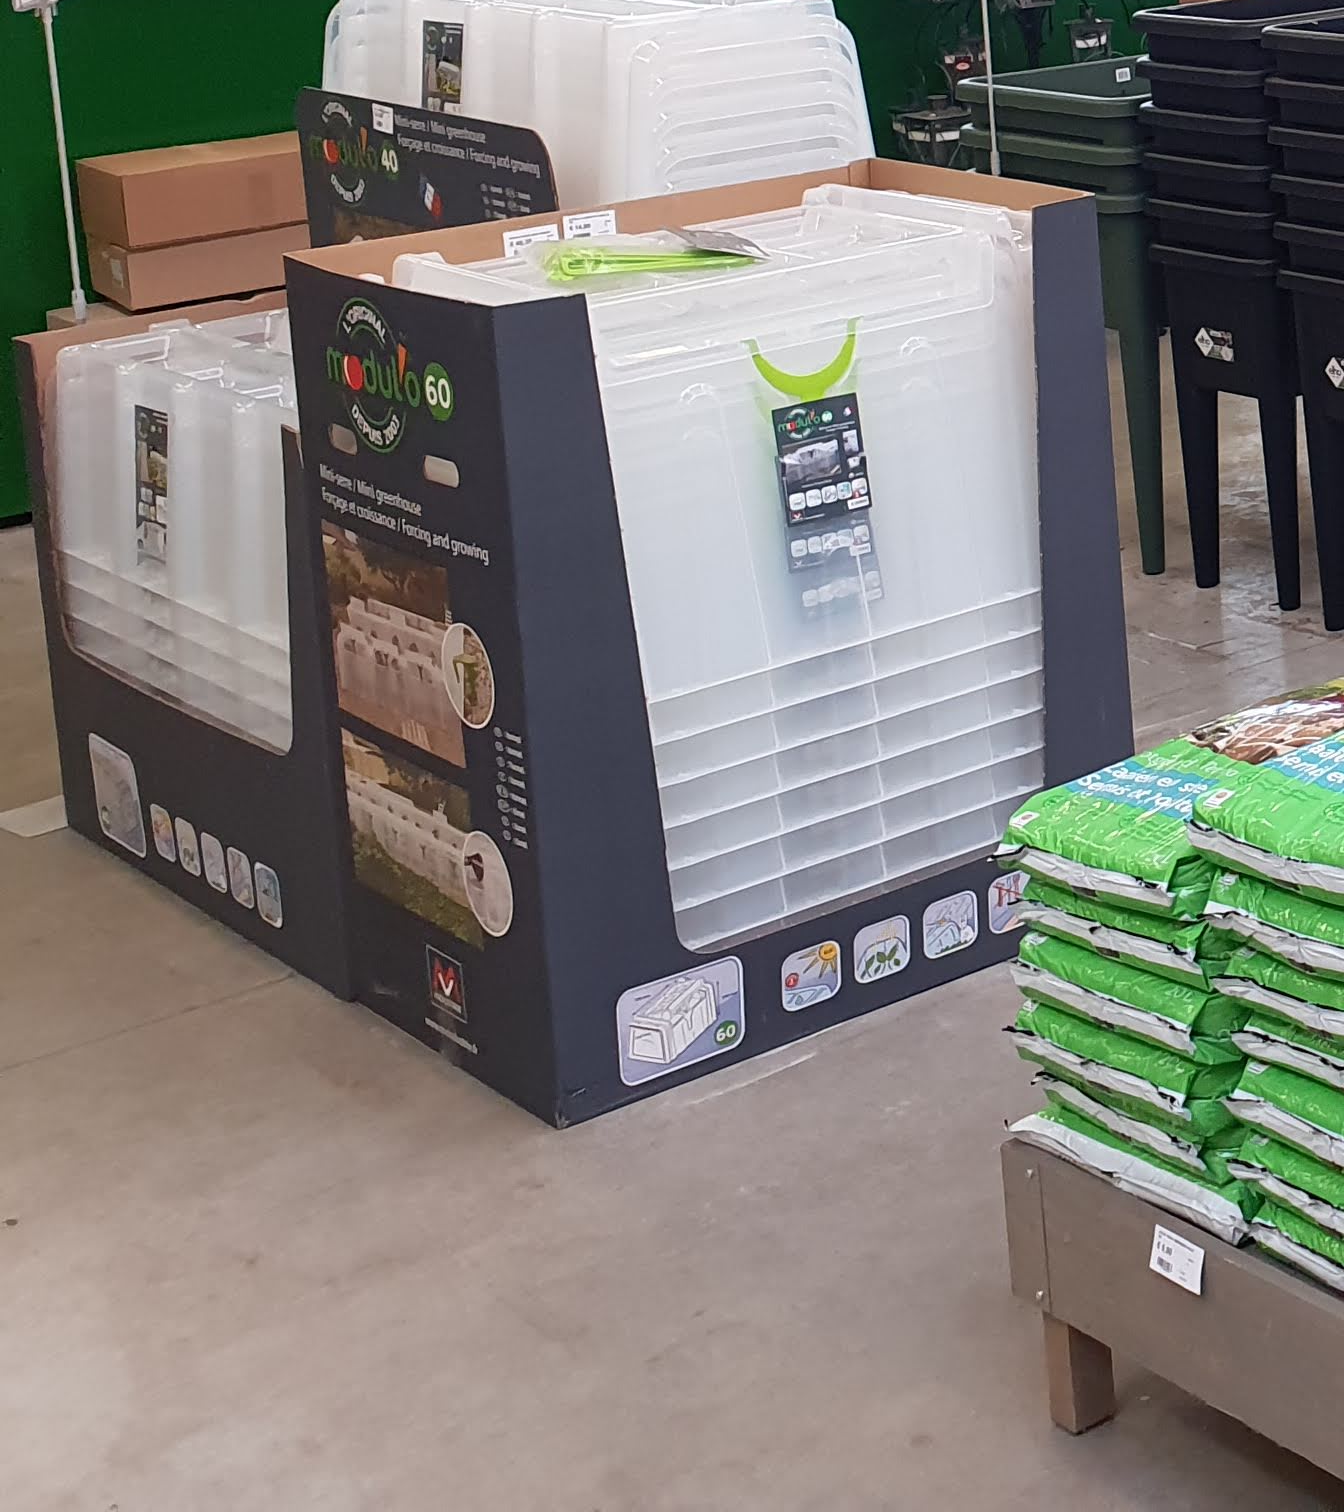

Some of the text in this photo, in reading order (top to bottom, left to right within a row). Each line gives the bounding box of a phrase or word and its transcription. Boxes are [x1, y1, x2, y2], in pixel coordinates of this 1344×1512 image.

[381, 148, 398, 173] 40
[425, 374, 451, 409] 60
[352, 404, 383, 445] DEPUIS
[357, 478, 376, 498] Mini
[376, 487, 422, 517] greenhouse
[401, 518, 432, 548] Forcing
[432, 532, 450, 550] and
[450, 538, 490, 566] growing
[714, 1022, 737, 1044] 60
